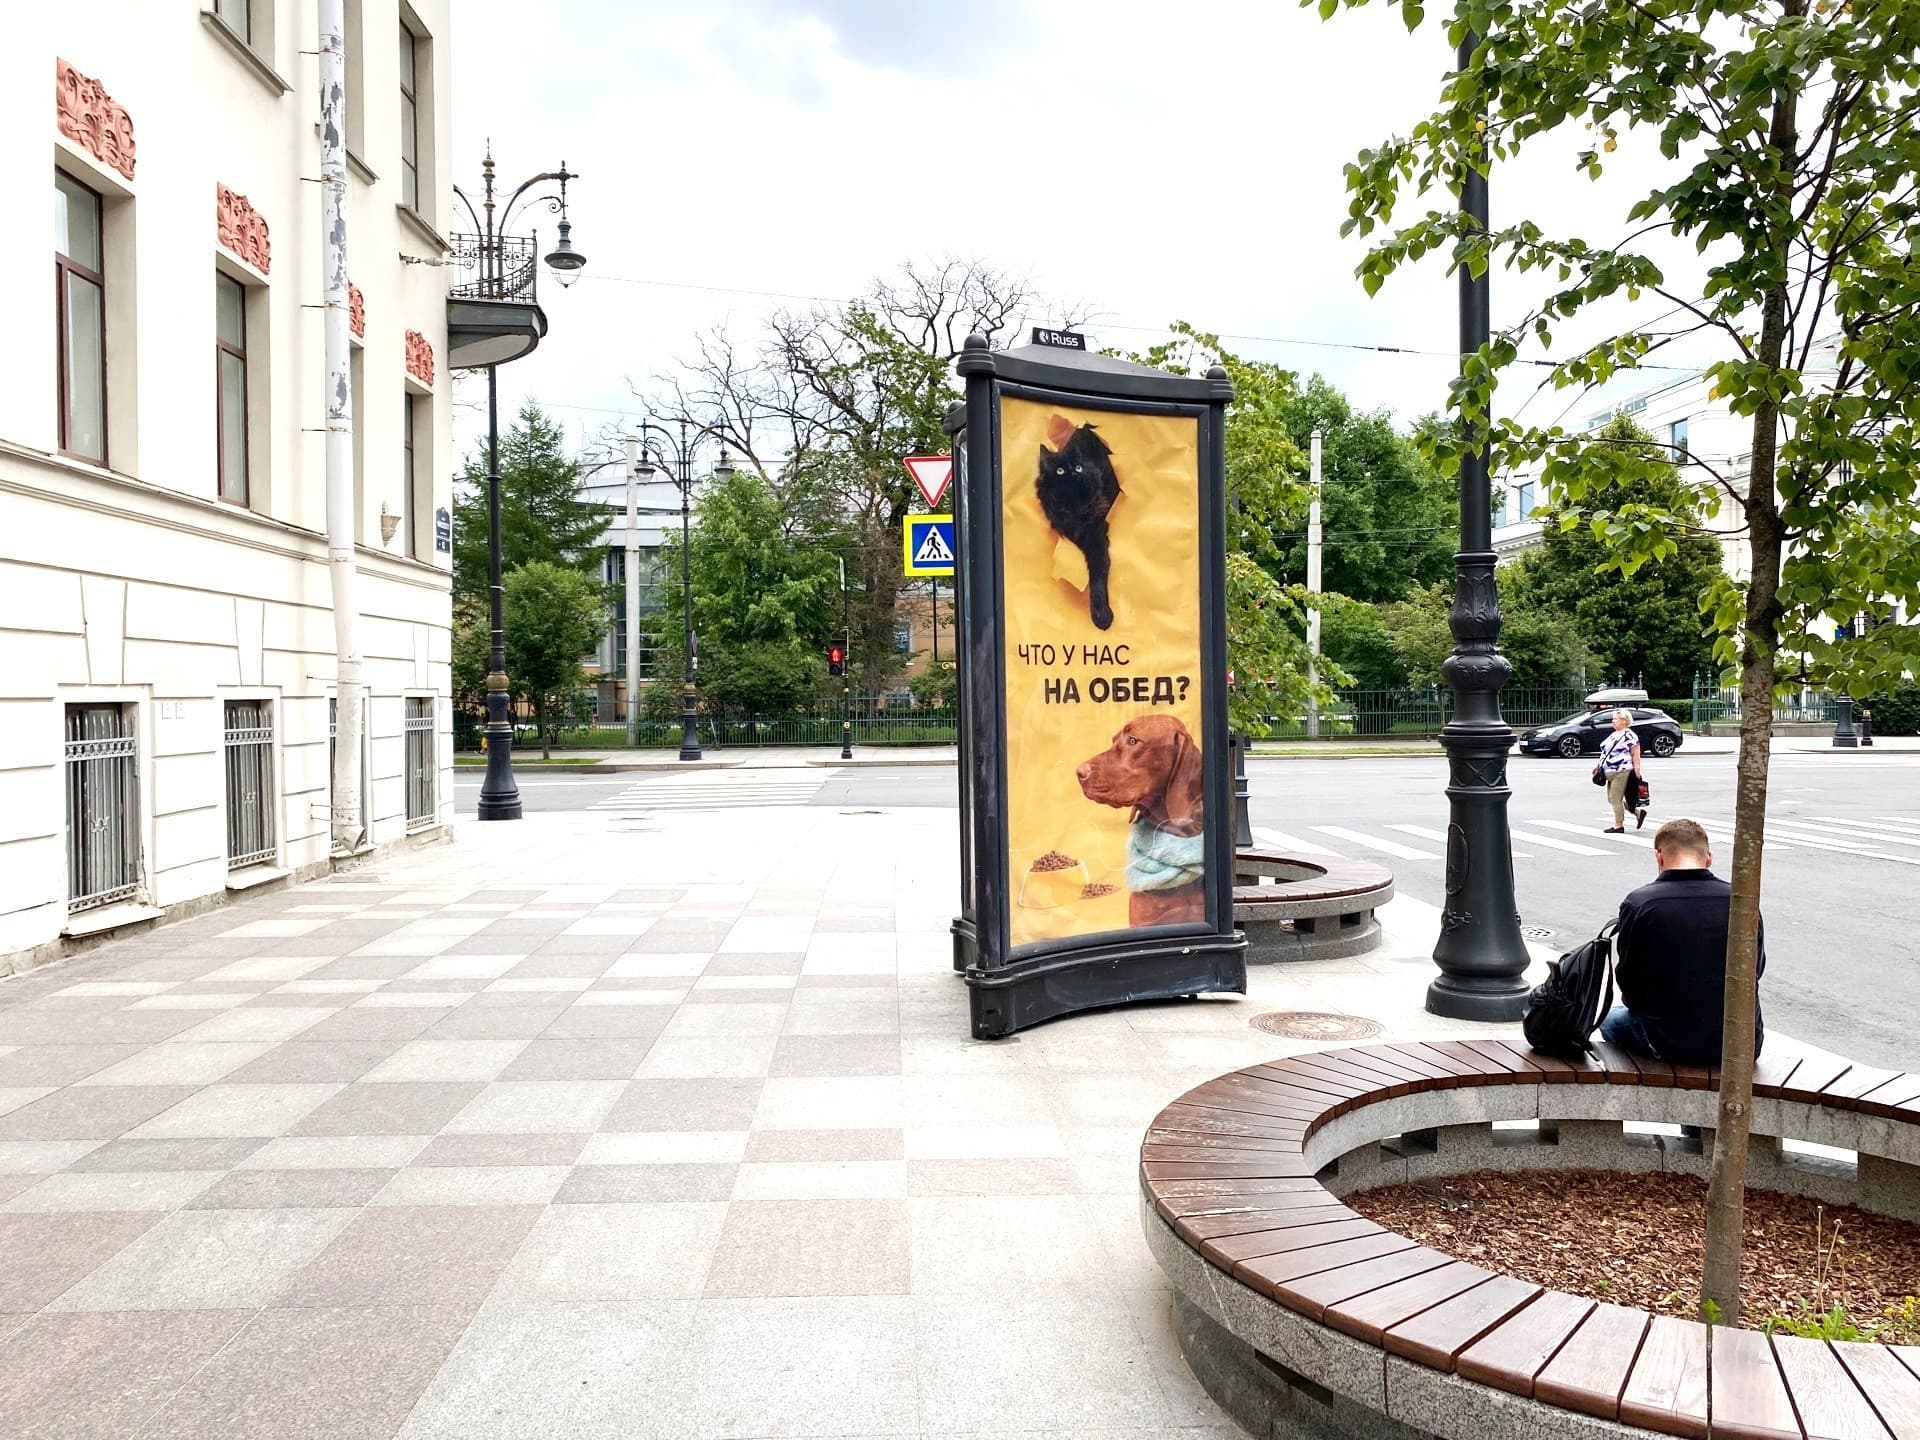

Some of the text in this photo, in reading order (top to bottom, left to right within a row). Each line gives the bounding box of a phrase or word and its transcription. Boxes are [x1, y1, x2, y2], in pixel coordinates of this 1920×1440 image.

[1050, 332, 1079, 347] Russ
[1018, 644, 1130, 666] ЧТО У НАС
[1044, 676, 1191, 706] НА ОБЕД?
